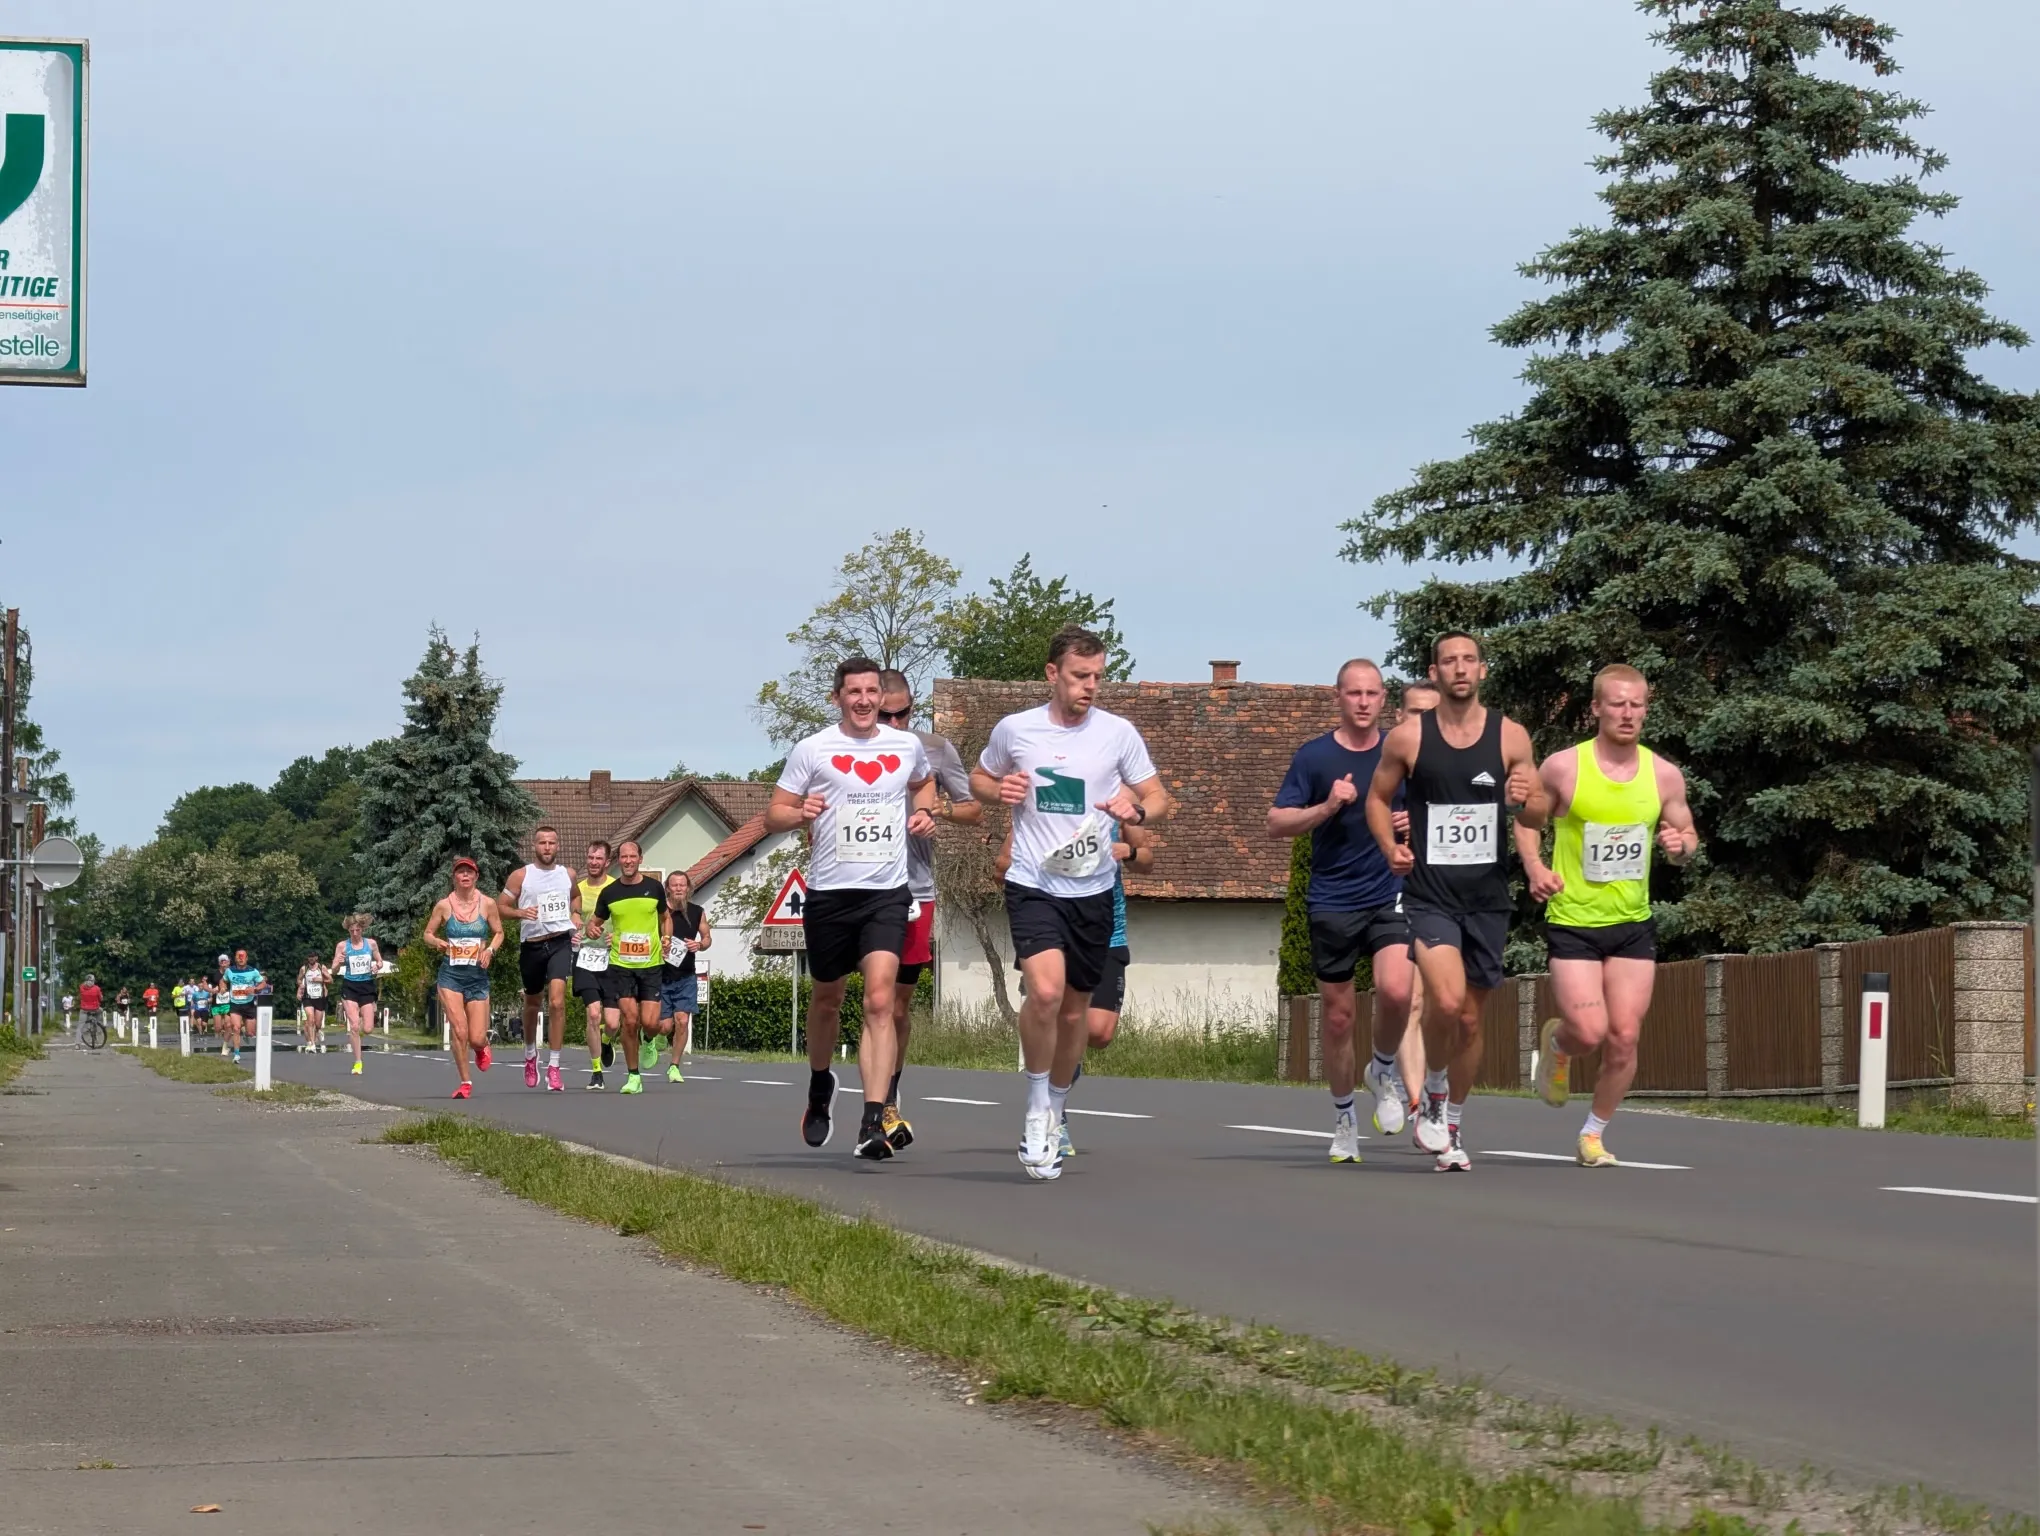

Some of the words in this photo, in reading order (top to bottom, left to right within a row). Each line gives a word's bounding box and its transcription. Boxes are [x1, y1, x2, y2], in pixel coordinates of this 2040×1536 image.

[0, 275, 59, 297] ITIGE
[0, 334, 60, 357] stelle
[842, 825, 893, 843] 1654
[1435, 824, 1488, 844] 1301
[1590, 843, 1642, 862] 1299
[541, 901, 566, 913] 1839
[456, 946, 471, 956] 96
[624, 943, 645, 953] 103
[671, 947, 683, 959] 02
[582, 953, 607, 964] 1574
